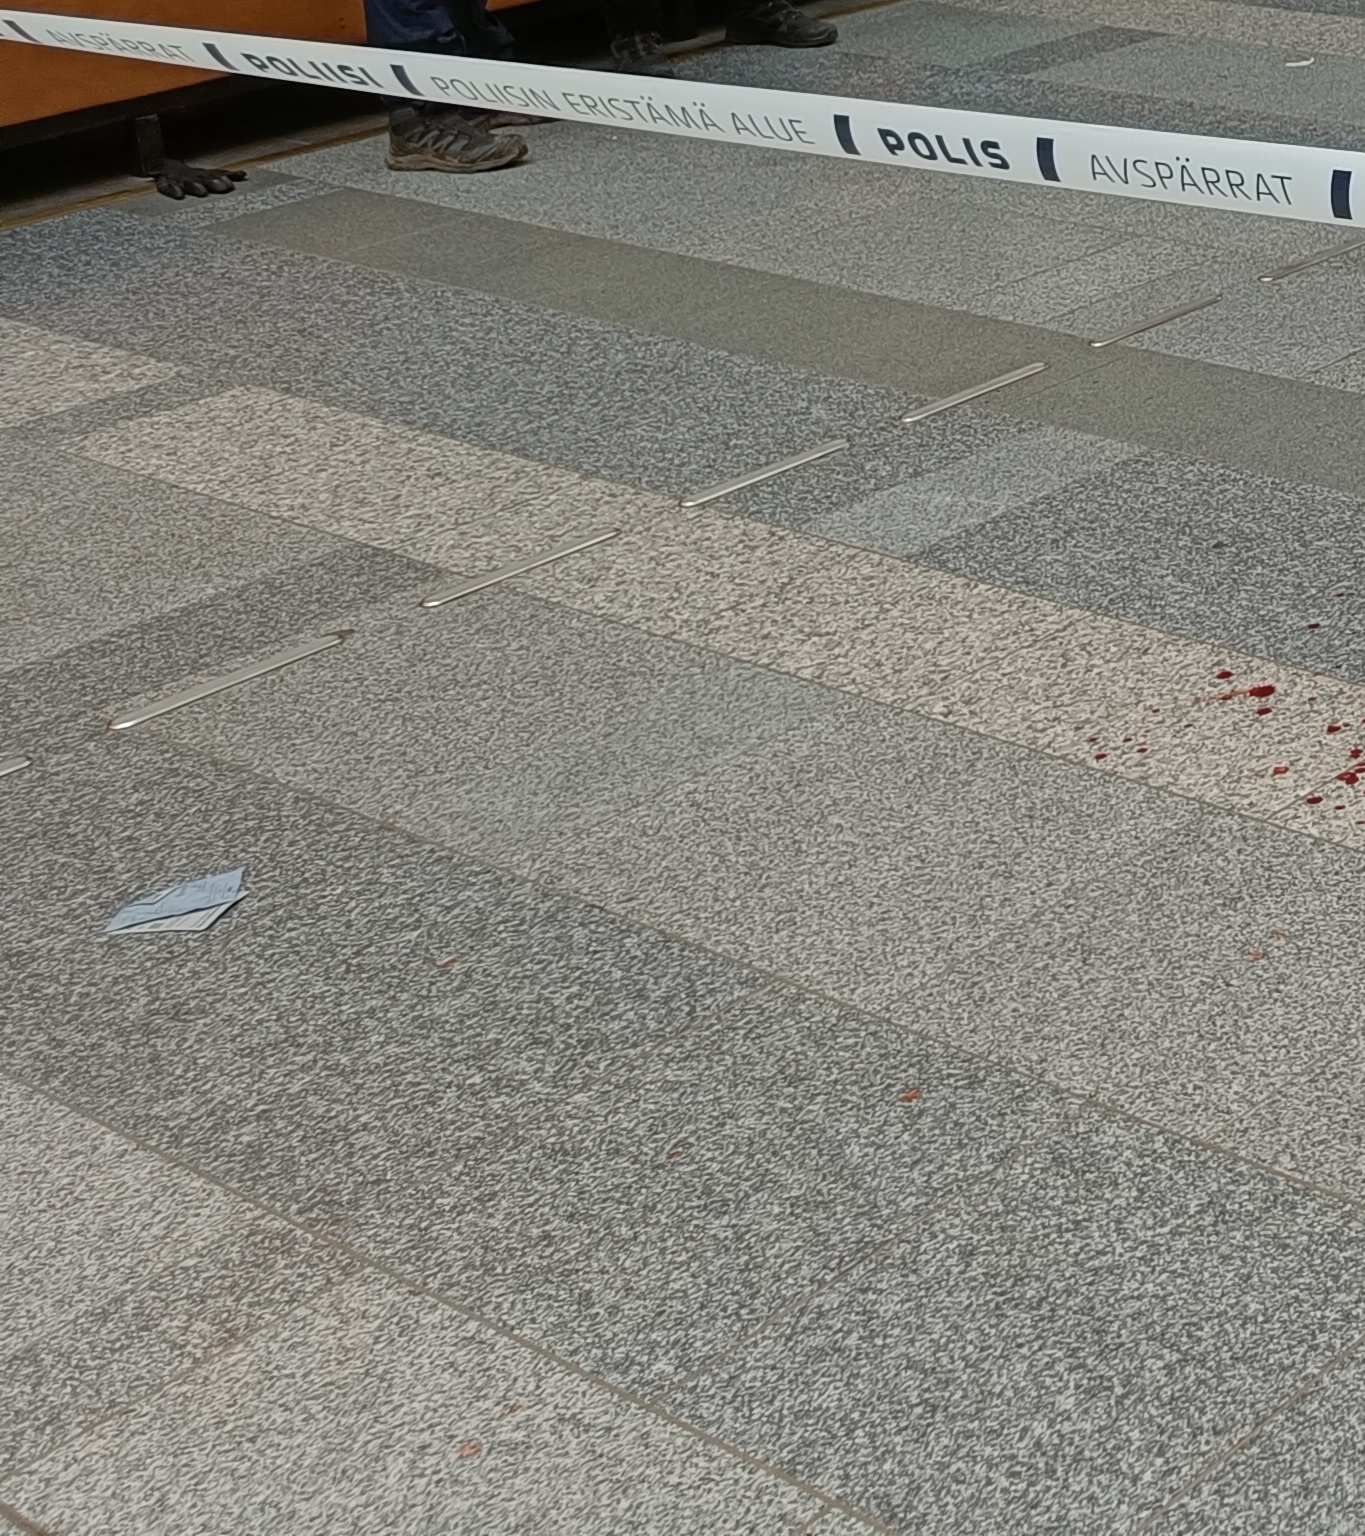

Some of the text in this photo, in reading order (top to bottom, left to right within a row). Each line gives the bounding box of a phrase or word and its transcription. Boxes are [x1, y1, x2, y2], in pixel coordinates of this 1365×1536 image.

[241, 51, 384, 89] POLIISI
[430, 76, 559, 112] POLIISIN
[562, 92, 725, 133] ERISTÄMÄ
[731, 111, 815, 145] ALUE
[877, 127, 1010, 170] POLIS
[1091, 154, 1293, 206] AVSPÄRRAT
